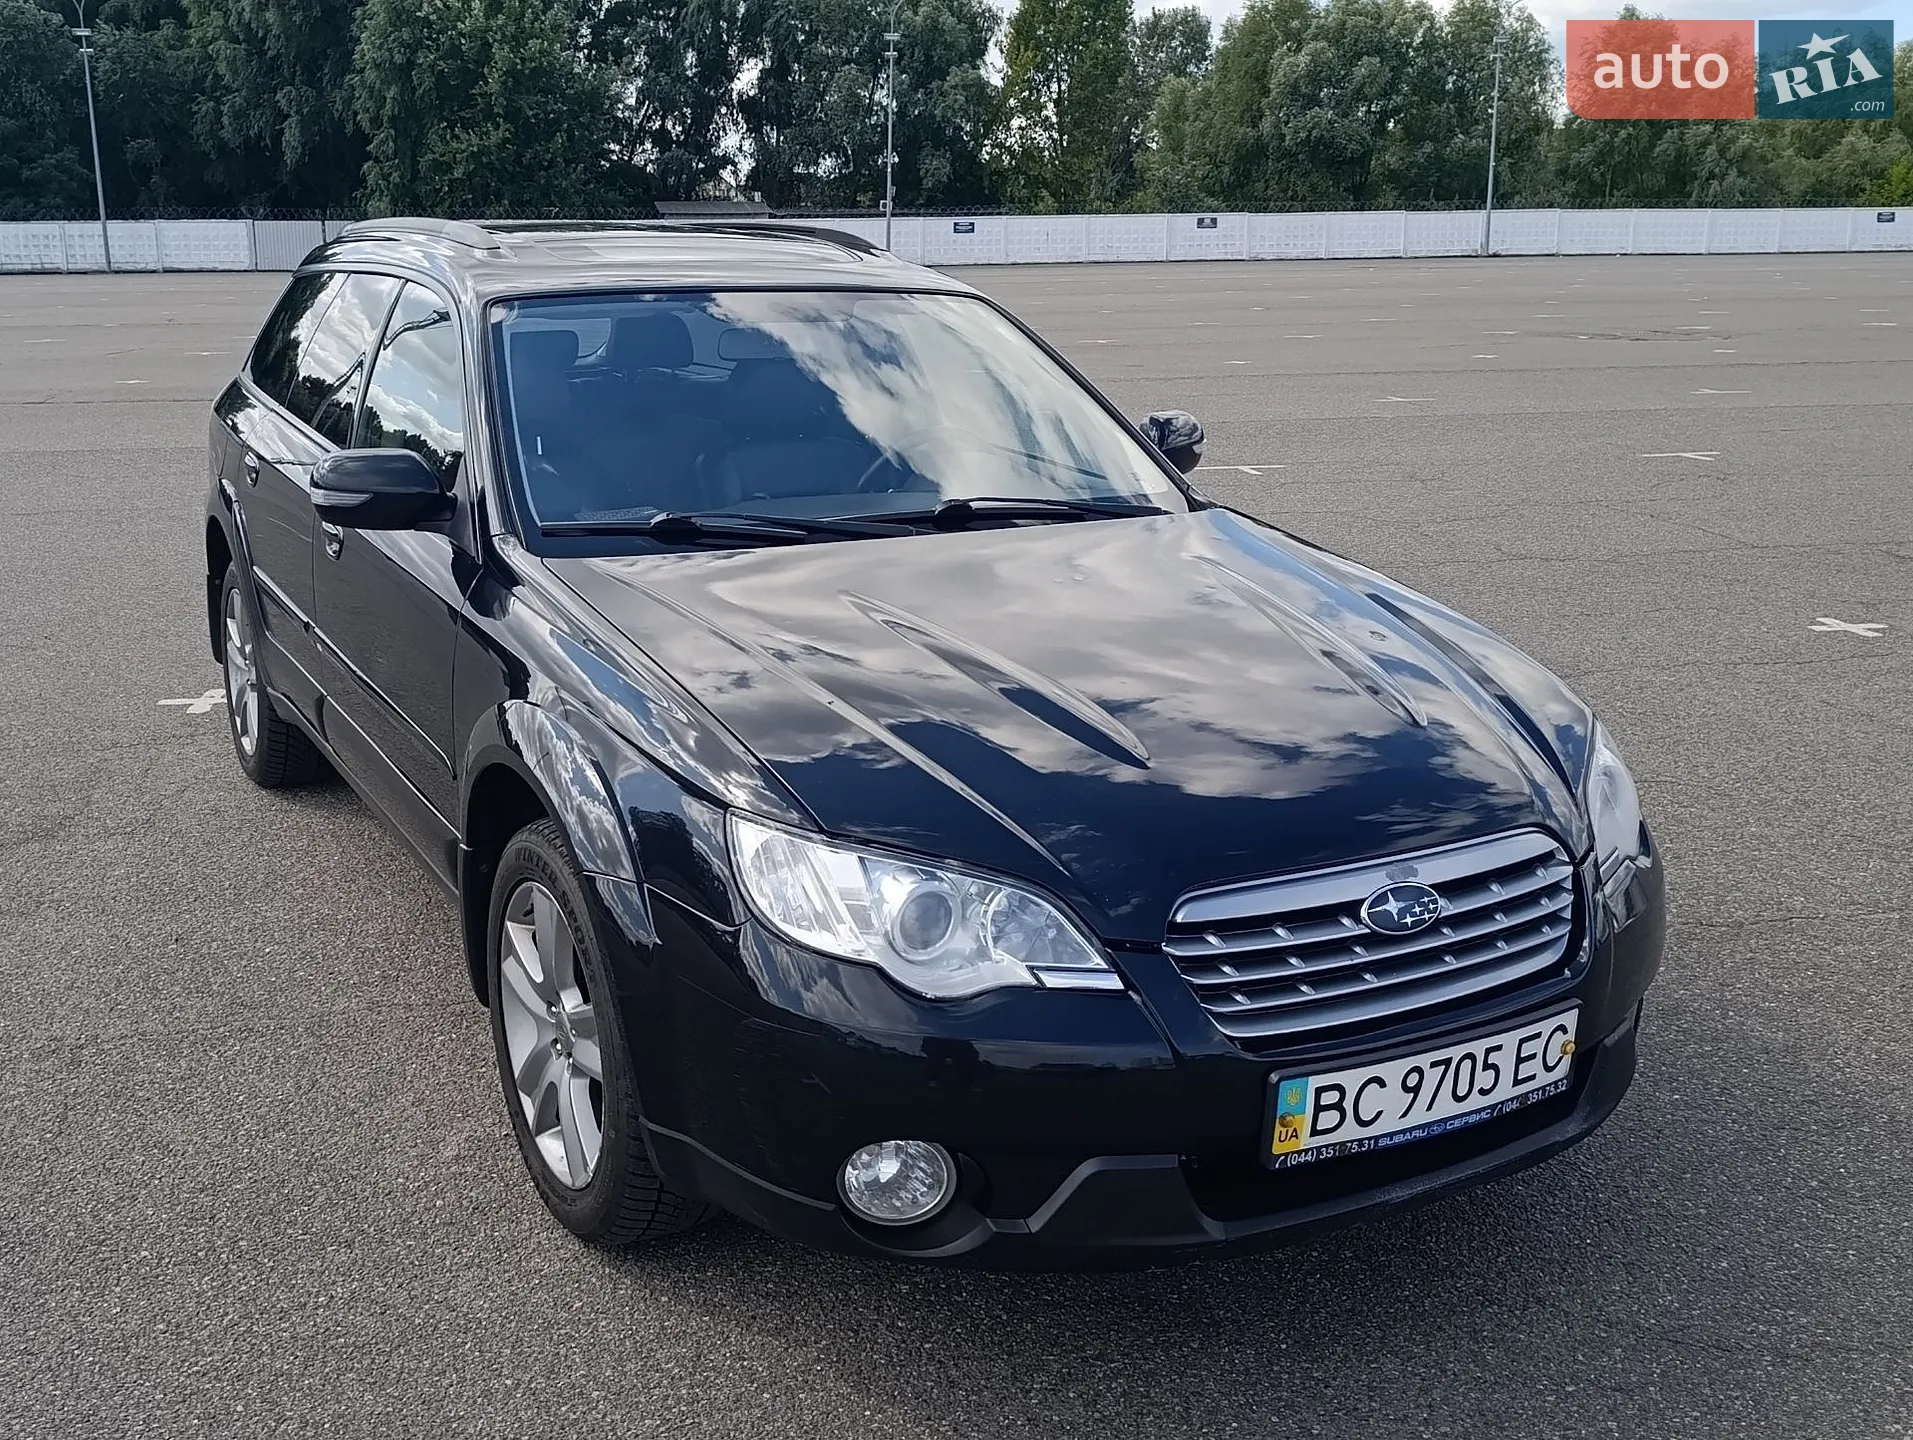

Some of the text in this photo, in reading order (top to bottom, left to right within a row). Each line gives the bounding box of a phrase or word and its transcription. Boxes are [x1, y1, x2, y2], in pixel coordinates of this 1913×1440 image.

[514, 848, 558, 889] WINTER
[1308, 1023, 1569, 1138] BC 9705 EC
[1446, 1109, 1492, 1129] СЕРВИС
[1527, 1079, 1568, 1104] 351.75.32
[1278, 1127, 1299, 1143] UA
[1287, 1127, 1428, 1167] (044) 35175.31 SUBARU
